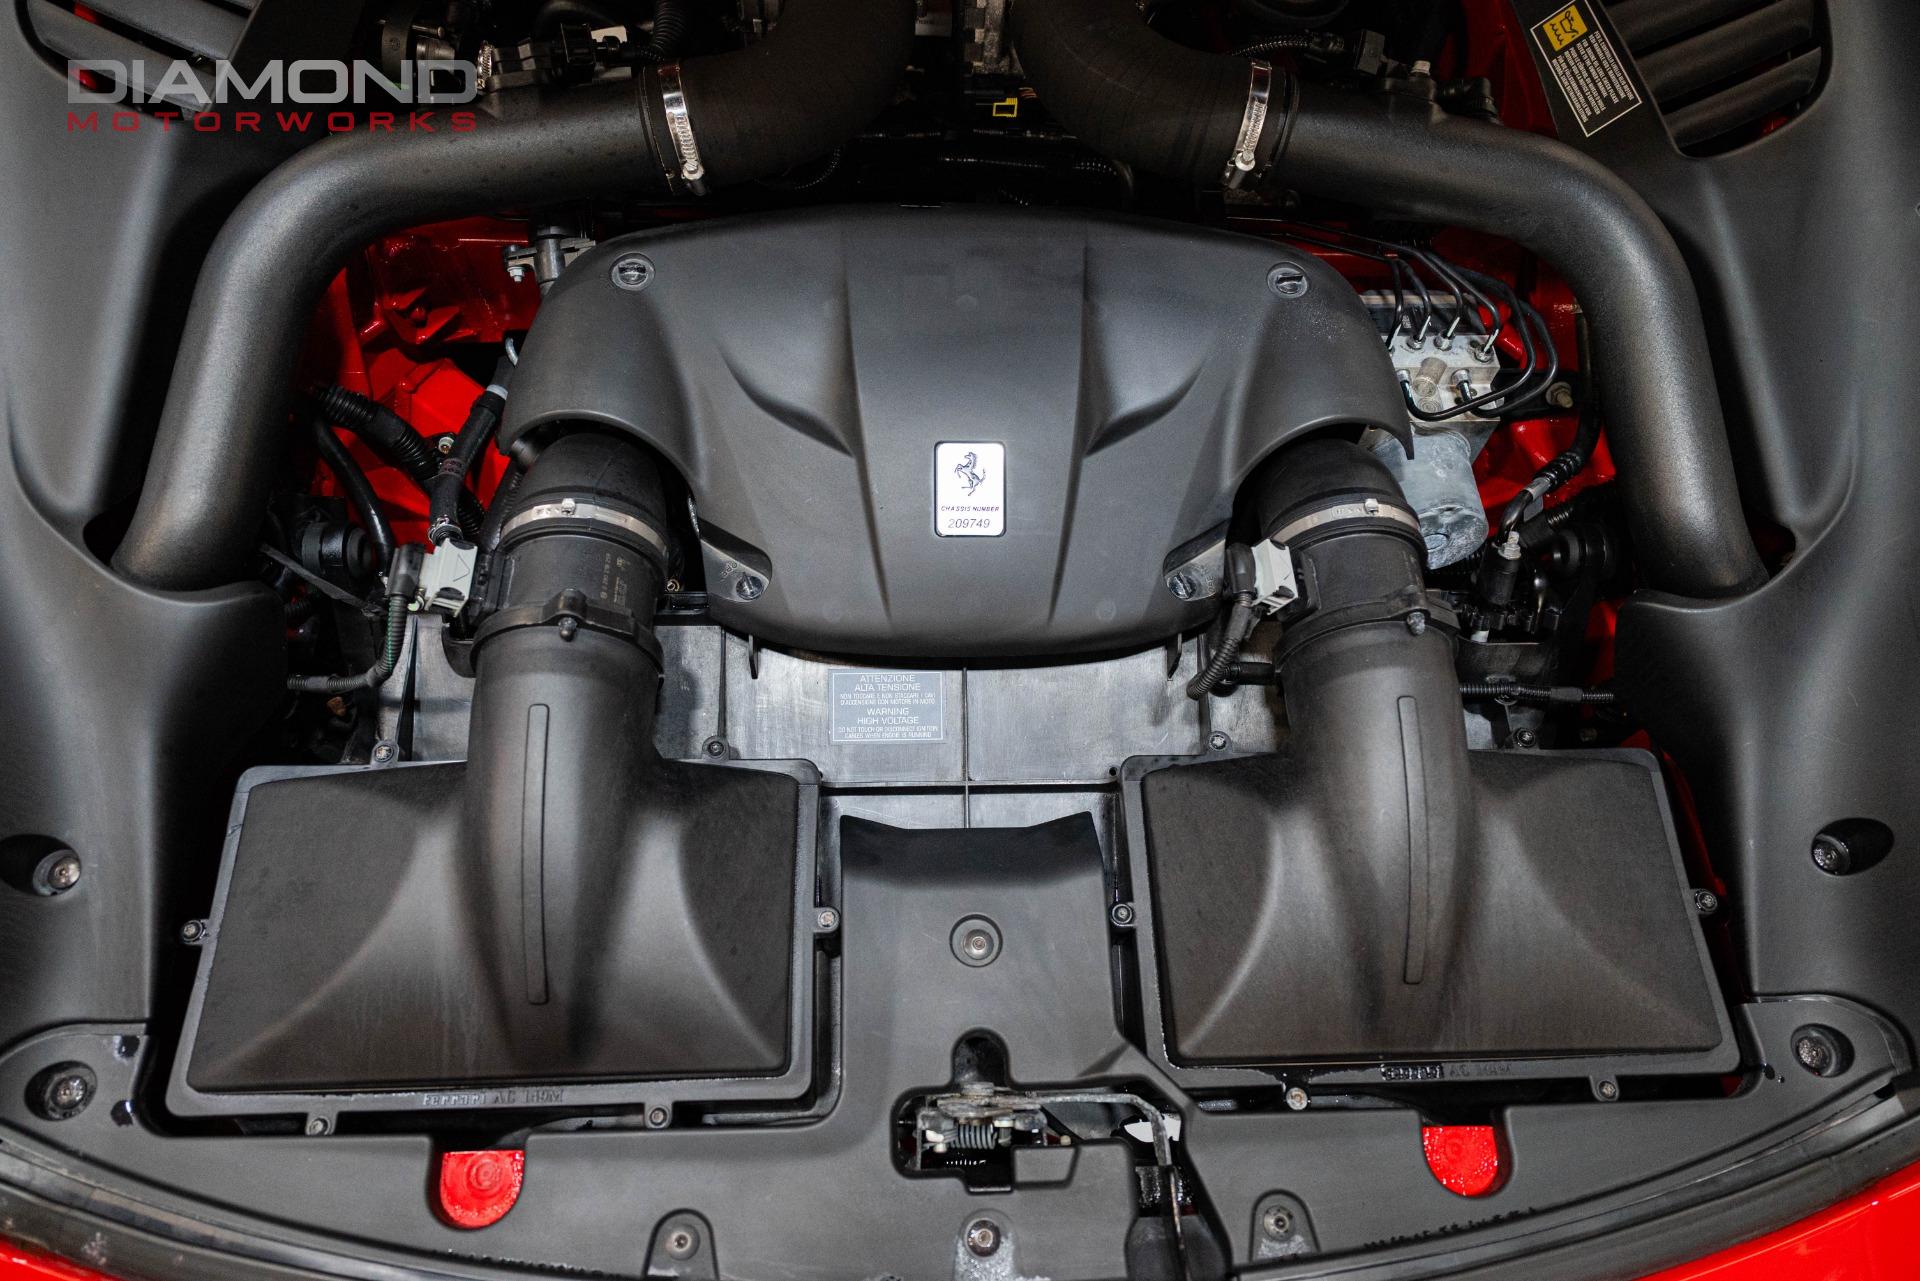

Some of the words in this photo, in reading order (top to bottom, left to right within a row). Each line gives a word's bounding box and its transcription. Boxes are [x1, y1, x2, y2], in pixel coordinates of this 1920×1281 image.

[948, 518, 991, 529] 209749
[860, 674, 916, 682] ATTENZIONE
[855, 684, 875, 692] ALTA
[877, 683, 921, 691] TENSIONE
[867, 707, 910, 716] WARNING
[857, 717, 879, 725] HIGH
[881, 716, 919, 725] VOLTAGE
[422, 1092, 487, 1106] Ferrari
